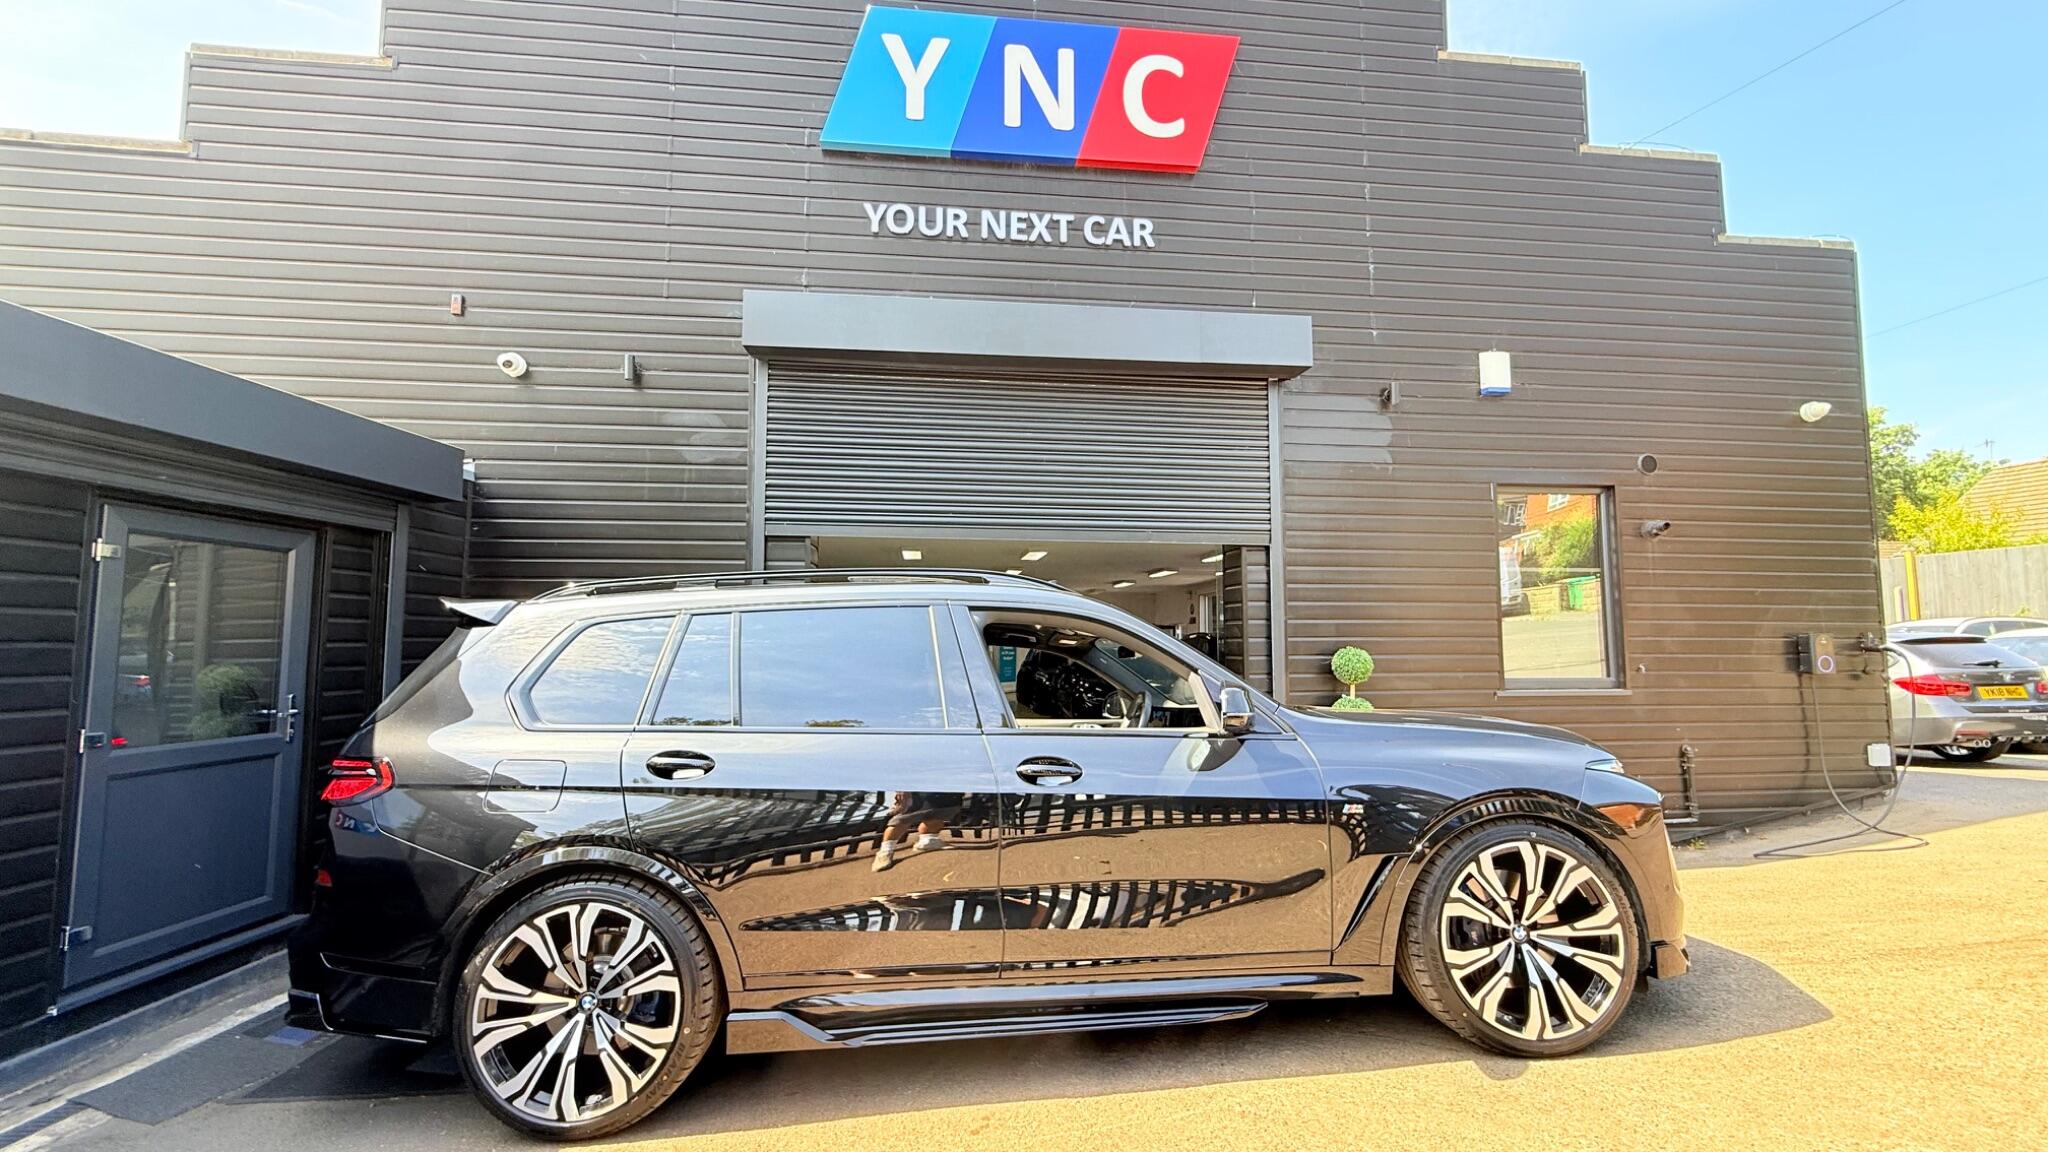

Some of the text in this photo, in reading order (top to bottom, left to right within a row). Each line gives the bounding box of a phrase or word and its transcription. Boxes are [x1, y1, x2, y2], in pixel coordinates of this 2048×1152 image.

[881, 33, 1186, 138] YNC
[863, 203, 1156, 249] YOUR NEXT CAR
